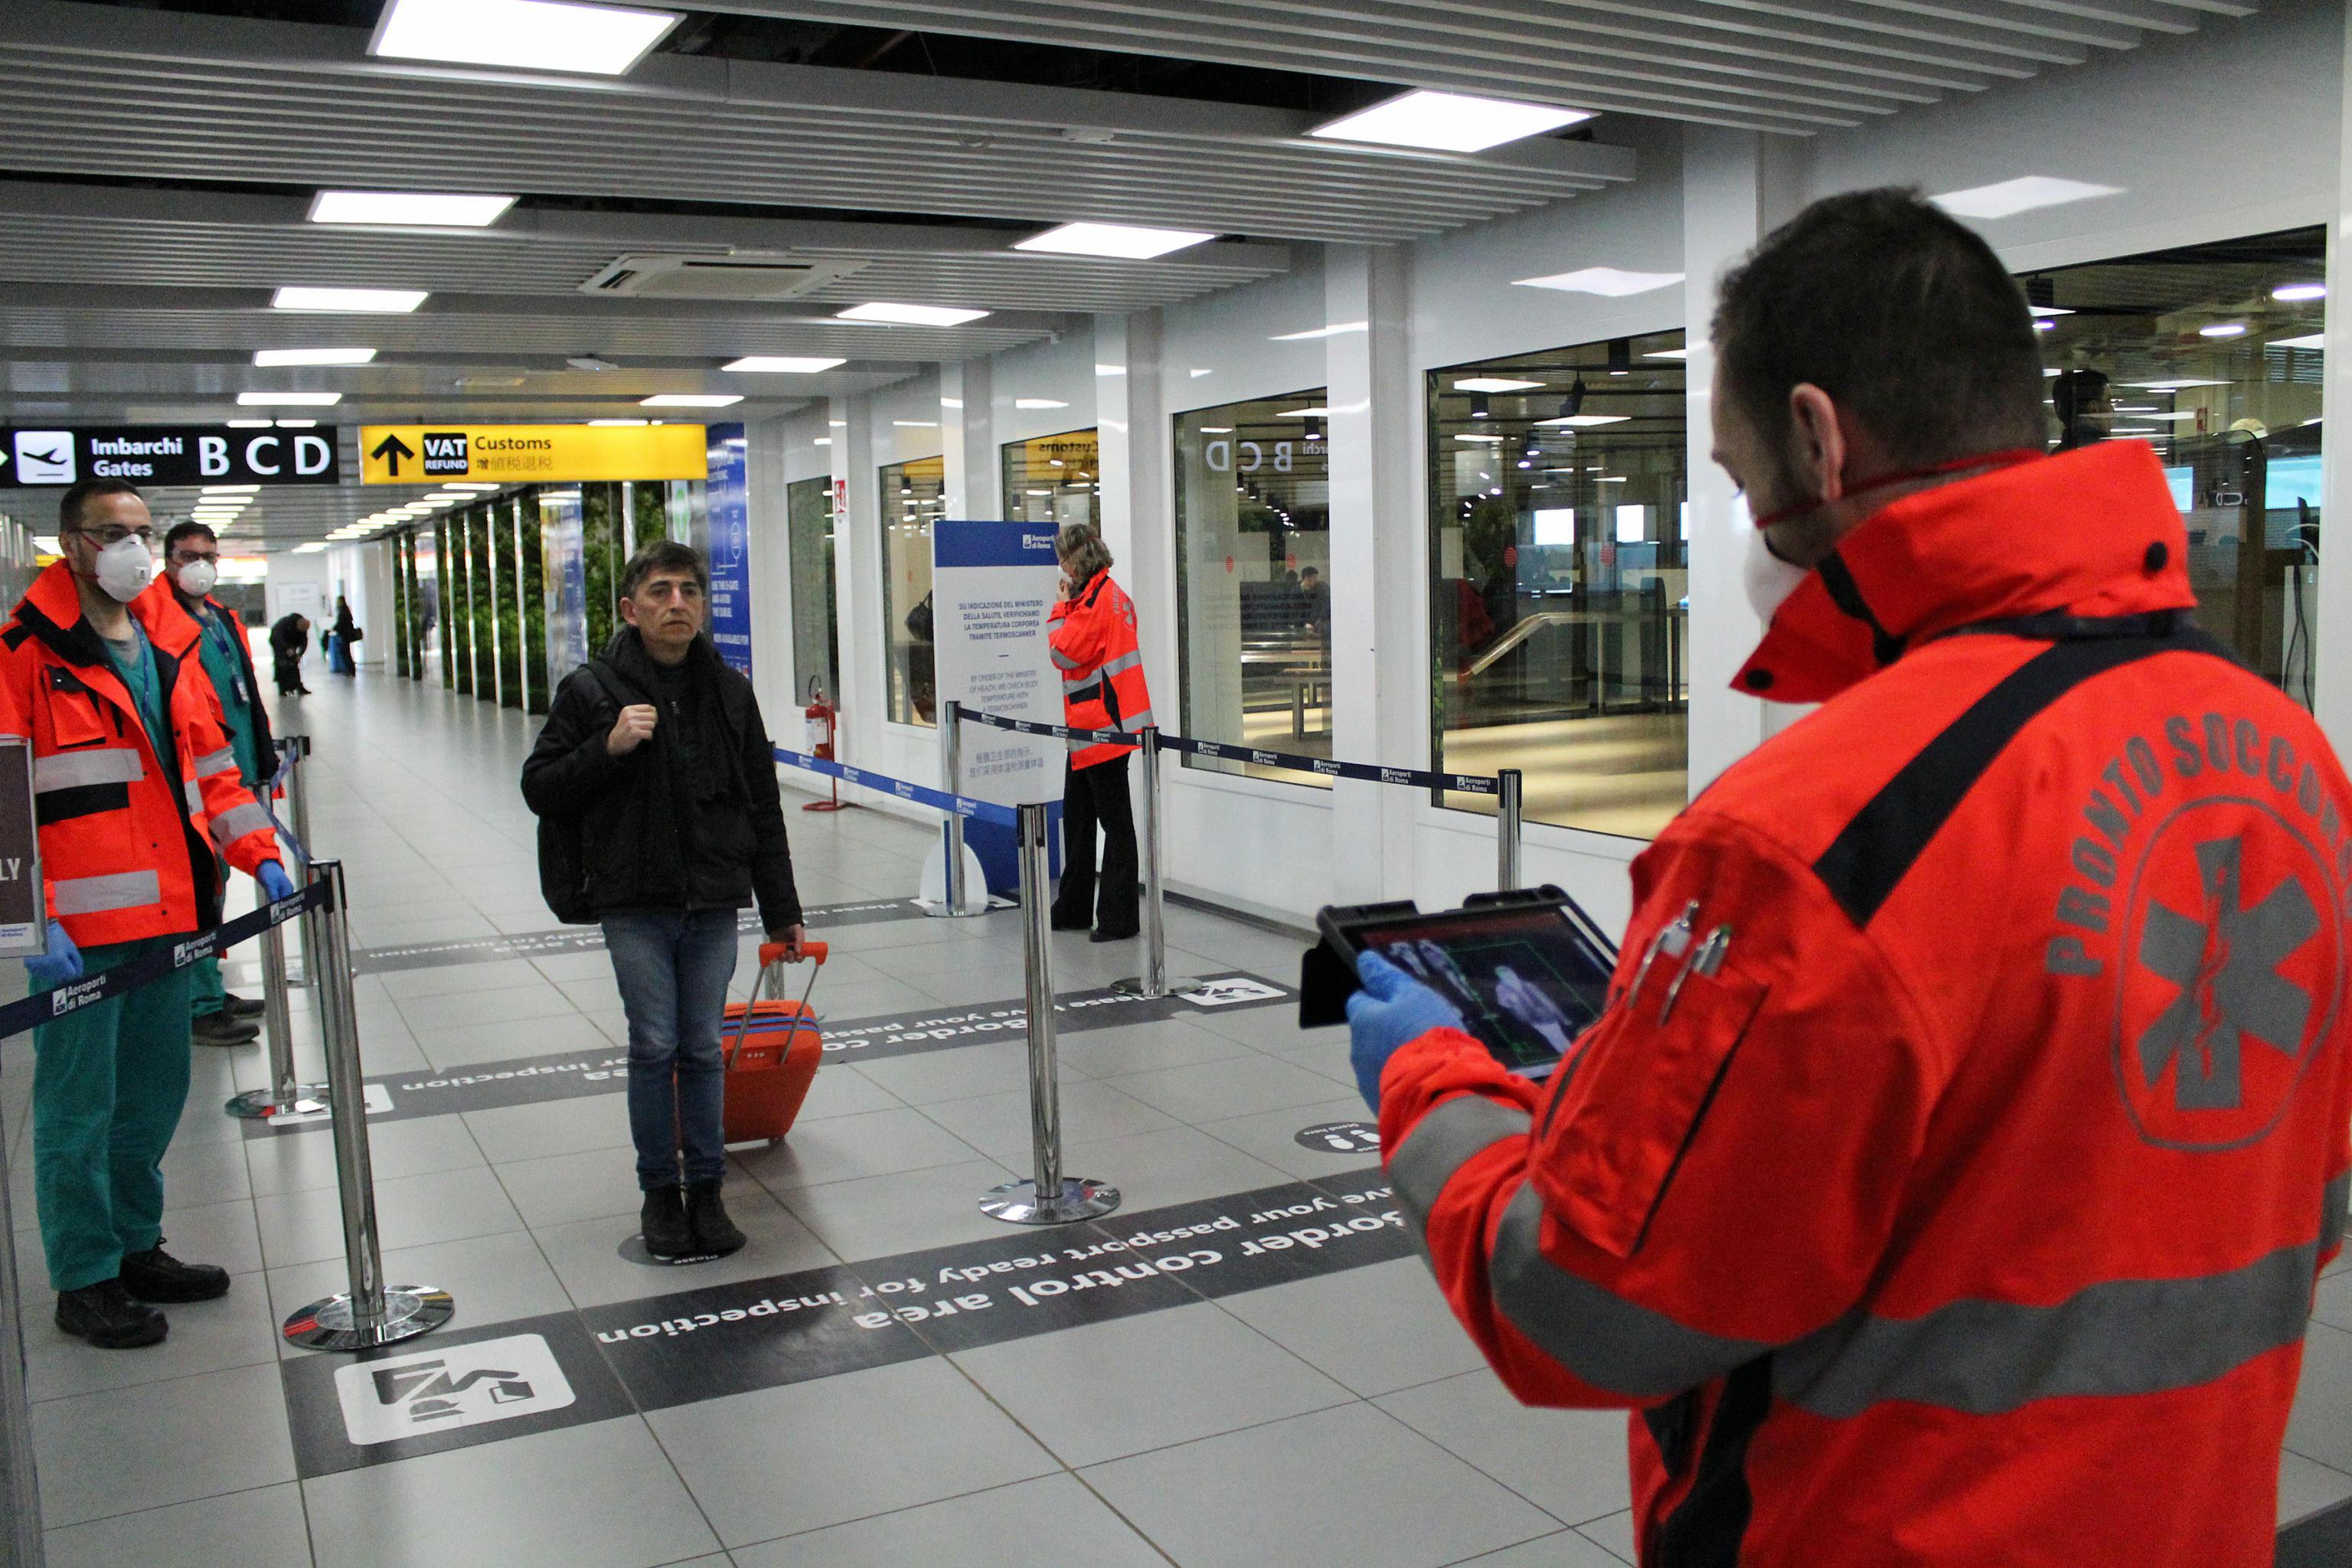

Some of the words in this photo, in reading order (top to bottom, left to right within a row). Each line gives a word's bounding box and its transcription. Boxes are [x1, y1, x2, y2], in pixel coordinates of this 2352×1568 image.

[91, 437, 183, 456] Imbarchi
[423, 439, 467, 457] VAT
[475, 436, 552, 450] Customs
[198, 436, 230, 477] B
[245, 436, 281, 475] C
[293, 435, 332, 475] D
[425, 460, 468, 470] REFUND
[93, 459, 154, 478] Gates
[968, 601, 1002, 609] INDICAZIONE
[1014, 599, 1044, 608] MINISTERO
[993, 630, 1036, 639] TERMOSCANNER
[1320, 760, 1341, 769] Aeroporti
[1389, 769, 1412, 778] Aeroporti
[1465, 777, 1491, 786] Aeroporti
[2046, 736, 2164, 976] PRONTO
[185, 931, 217, 952] Aeroporti
[185, 952, 193, 962] di
[194, 946, 213, 959] Roma
[67, 973, 106, 997] Aeroporti
[68, 999, 76, 1010] di
[78, 991, 101, 1007] Roma
[914, 1011, 985, 1030] your
[991, 1004, 1067, 1019] hve
[820, 1022, 905, 1040] passp
[886, 1018, 1027, 1045] Border
[599, 1057, 628, 1067] or
[401, 1061, 592, 1093] inspection
[1251, 1196, 1338, 1225] your
[1062, 1216, 1241, 1263] passport
[939, 1253, 1057, 1288] ready
[1008, 1248, 1223, 1306] control
[858, 1276, 926, 1298] for
[597, 1291, 849, 1344] inspection
[851, 1292, 994, 1331] area
